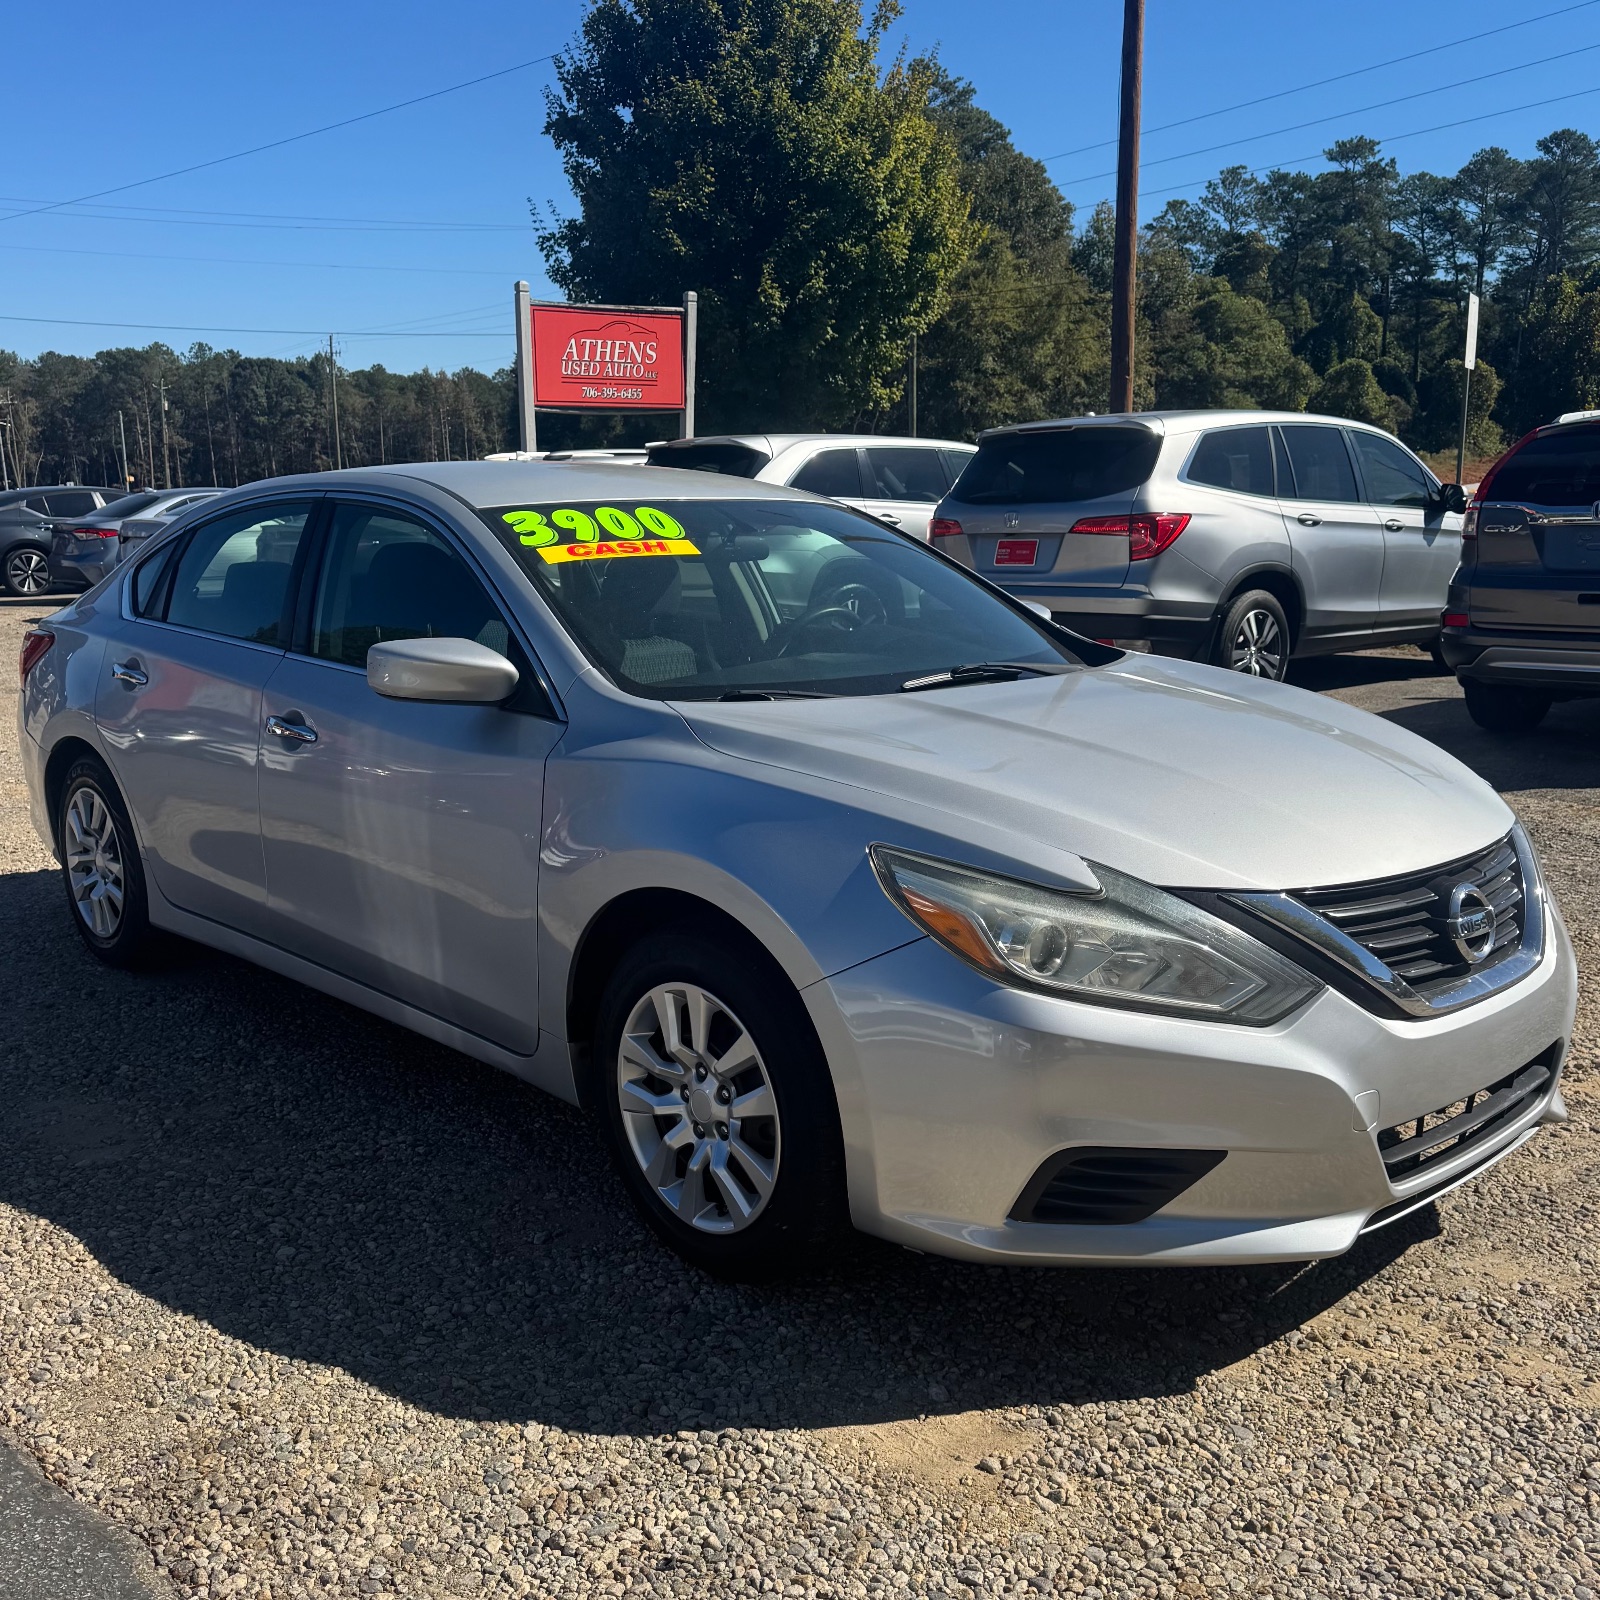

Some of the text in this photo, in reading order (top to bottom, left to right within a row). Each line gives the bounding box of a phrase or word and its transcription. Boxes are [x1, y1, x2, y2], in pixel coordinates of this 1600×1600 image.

[561, 338, 657, 364] ATHENS
[561, 360, 601, 377] USED
[603, 363, 645, 379] AUTO
[581, 386, 643, 400] 706-395-6455
[502, 507, 686, 548] 3900
[566, 541, 672, 558] CASH
